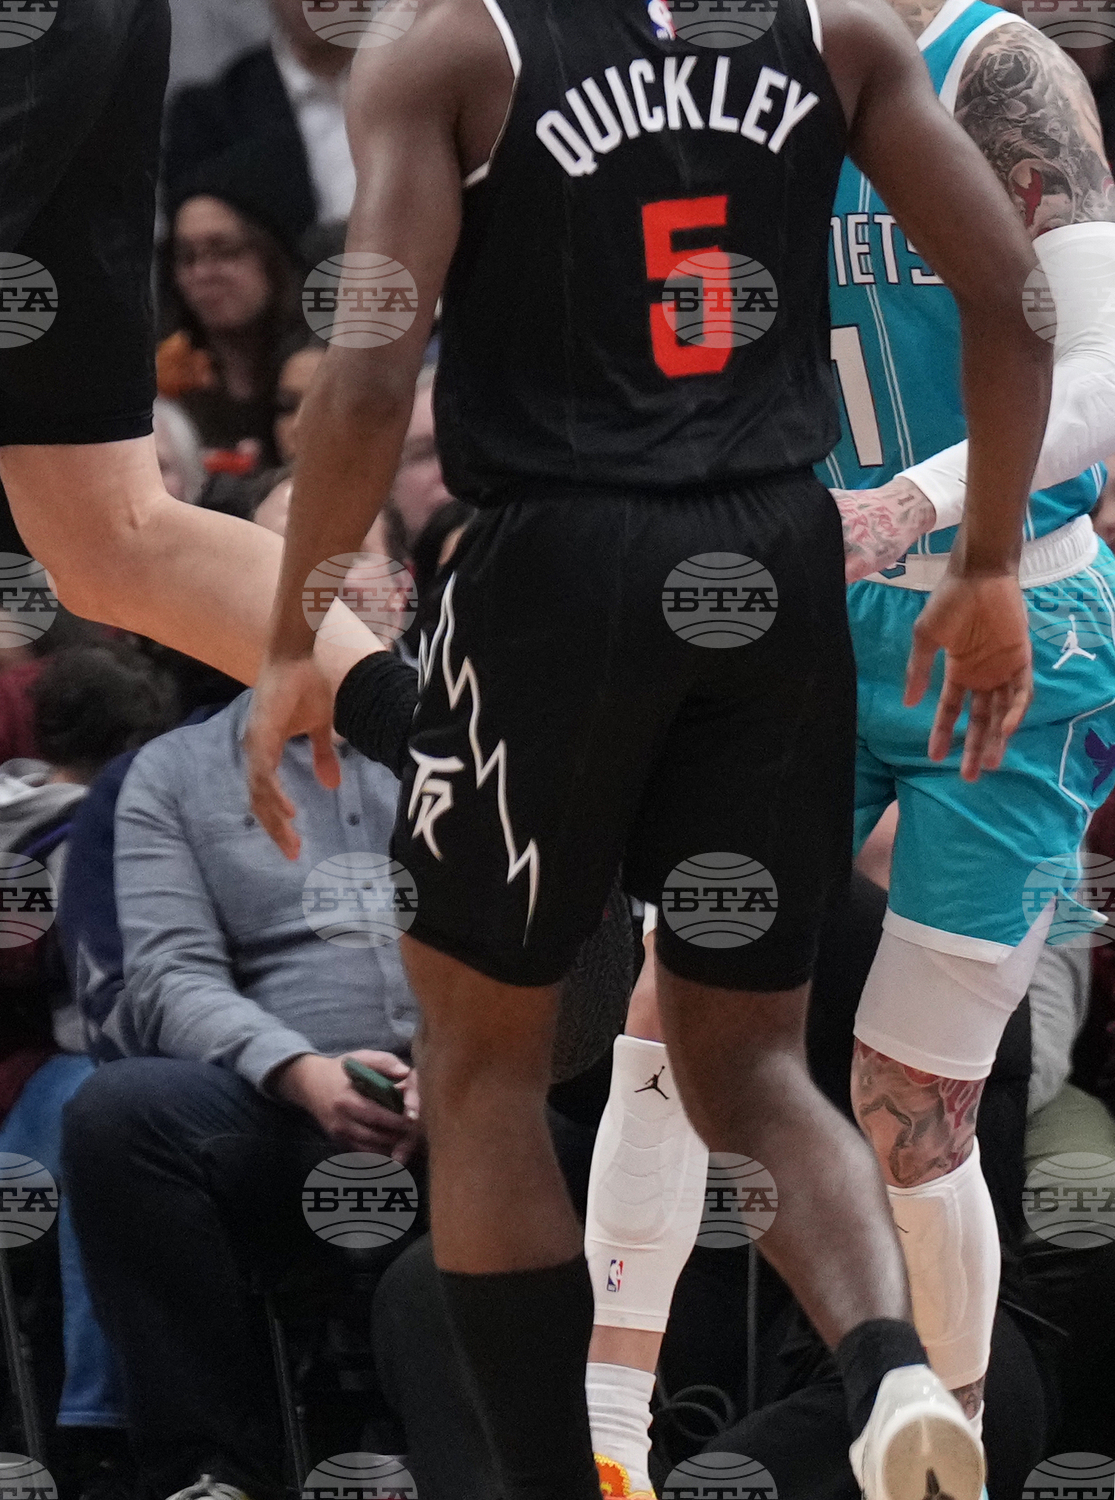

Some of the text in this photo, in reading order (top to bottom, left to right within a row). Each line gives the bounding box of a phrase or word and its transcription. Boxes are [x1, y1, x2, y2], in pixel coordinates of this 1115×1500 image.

[535, 55, 821, 178] QUICKLEY
[641, 194, 734, 380] 5
[830, 322, 885, 468] 1
